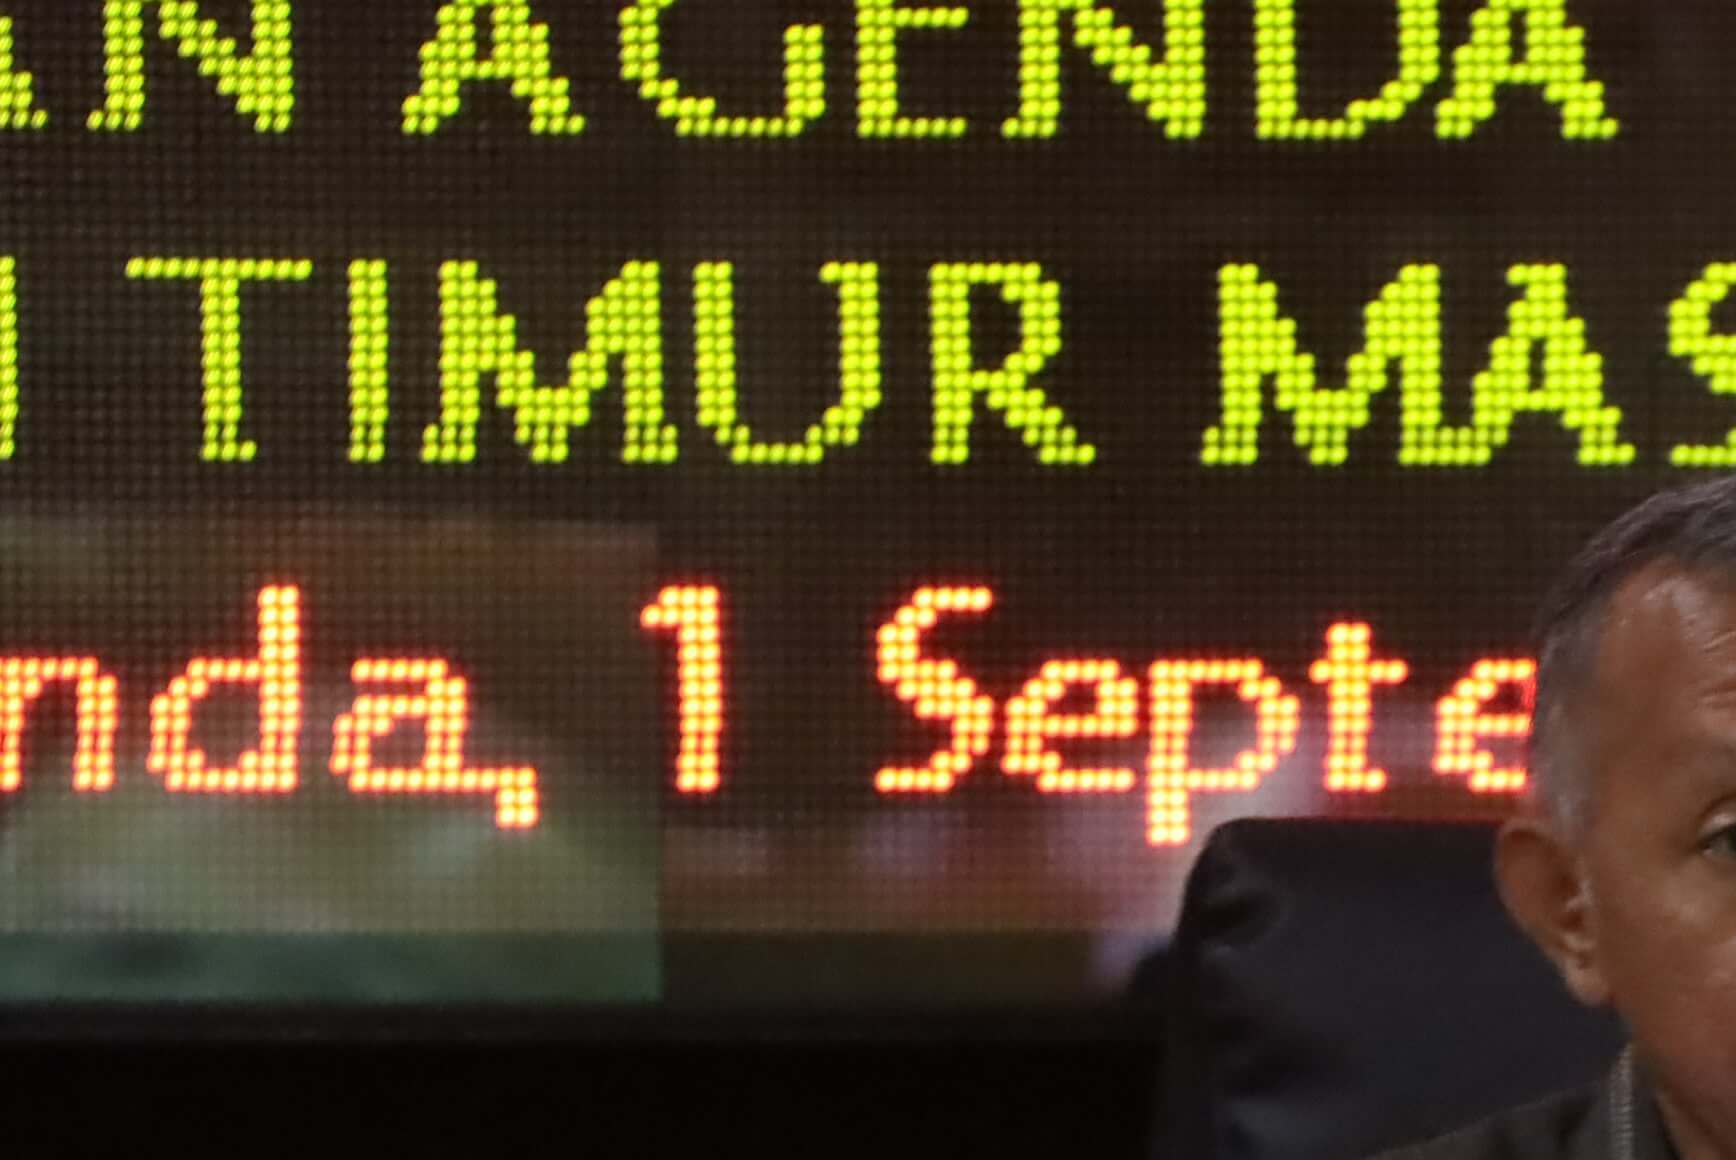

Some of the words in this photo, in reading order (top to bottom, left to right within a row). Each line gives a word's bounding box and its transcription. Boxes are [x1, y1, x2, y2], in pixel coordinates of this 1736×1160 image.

[401, 0, 1619, 139] AGENDA
[126, 256, 1096, 465] TIMUR
[640, 584, 725, 793] 1
